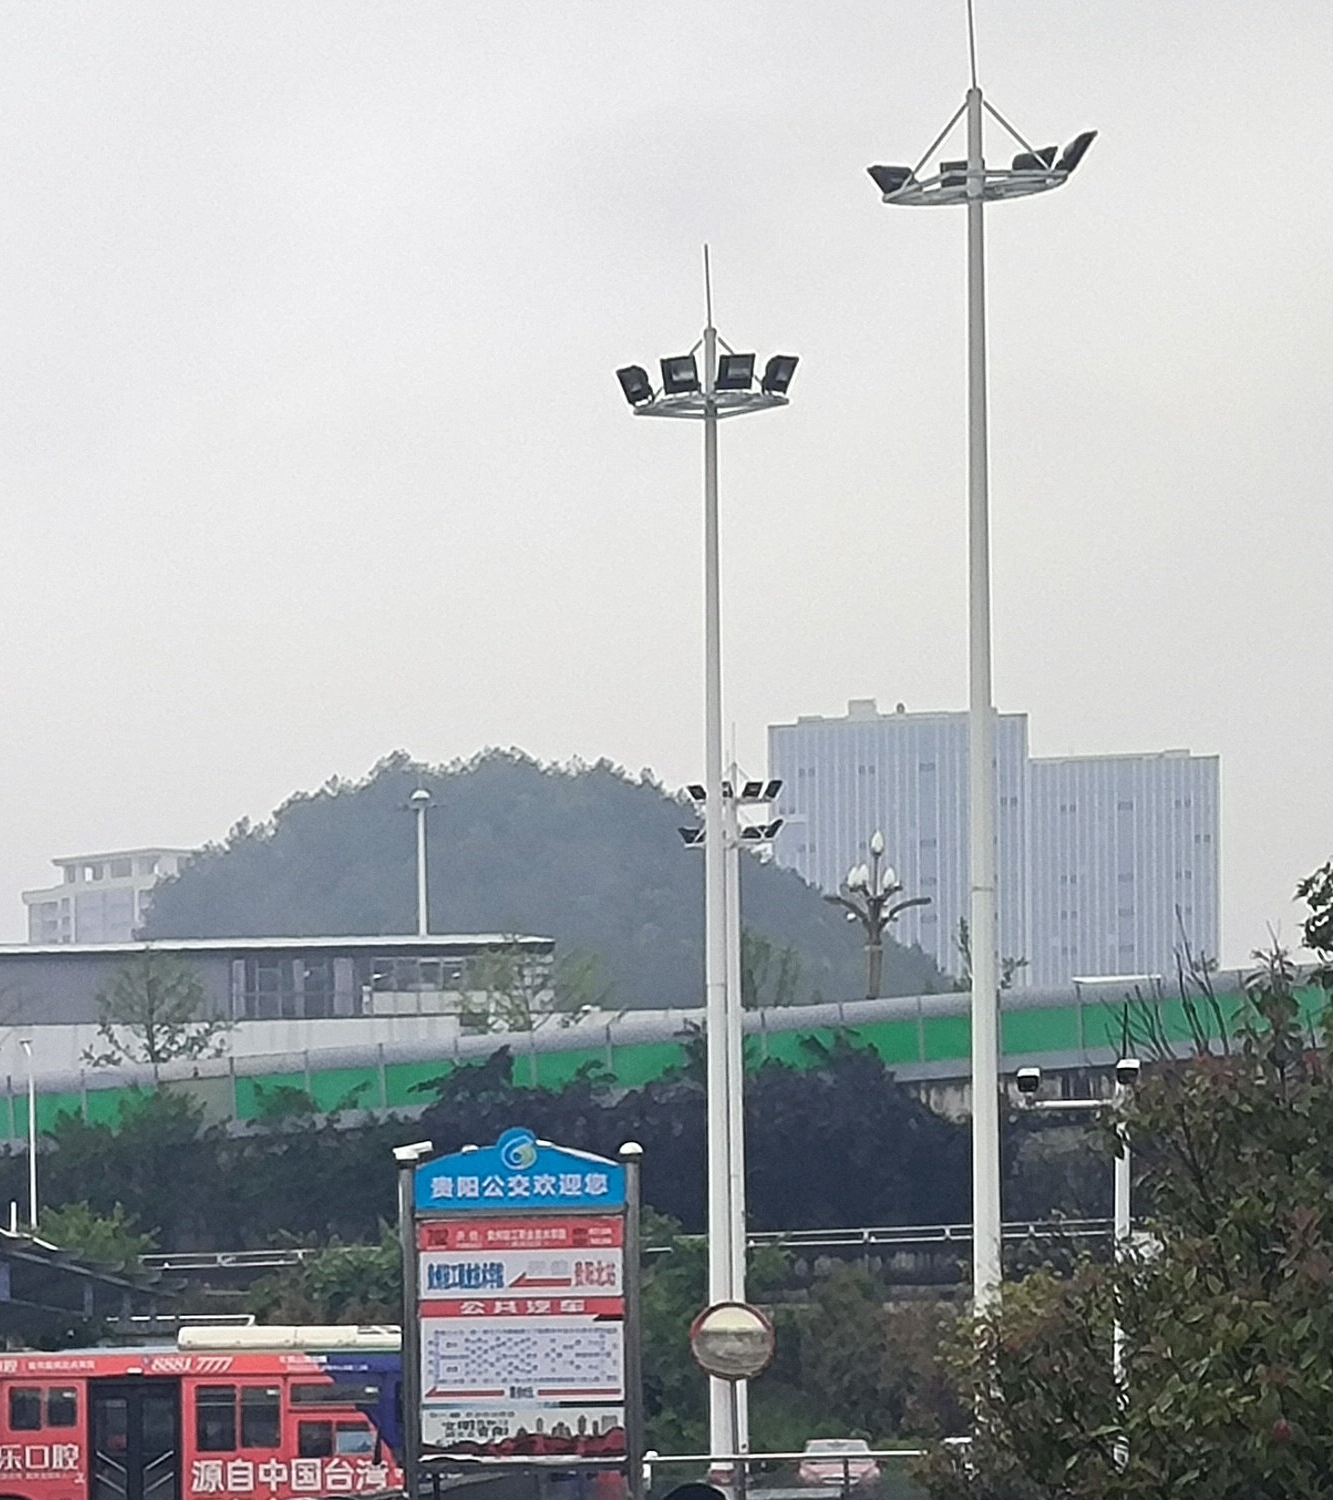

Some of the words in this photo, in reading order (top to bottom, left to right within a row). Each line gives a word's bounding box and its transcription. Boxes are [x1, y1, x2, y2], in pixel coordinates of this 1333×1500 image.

[430, 1173, 609, 1199] 贵阳公交欢迎您
[191, 1458, 389, 1493] 源自中国台湾
